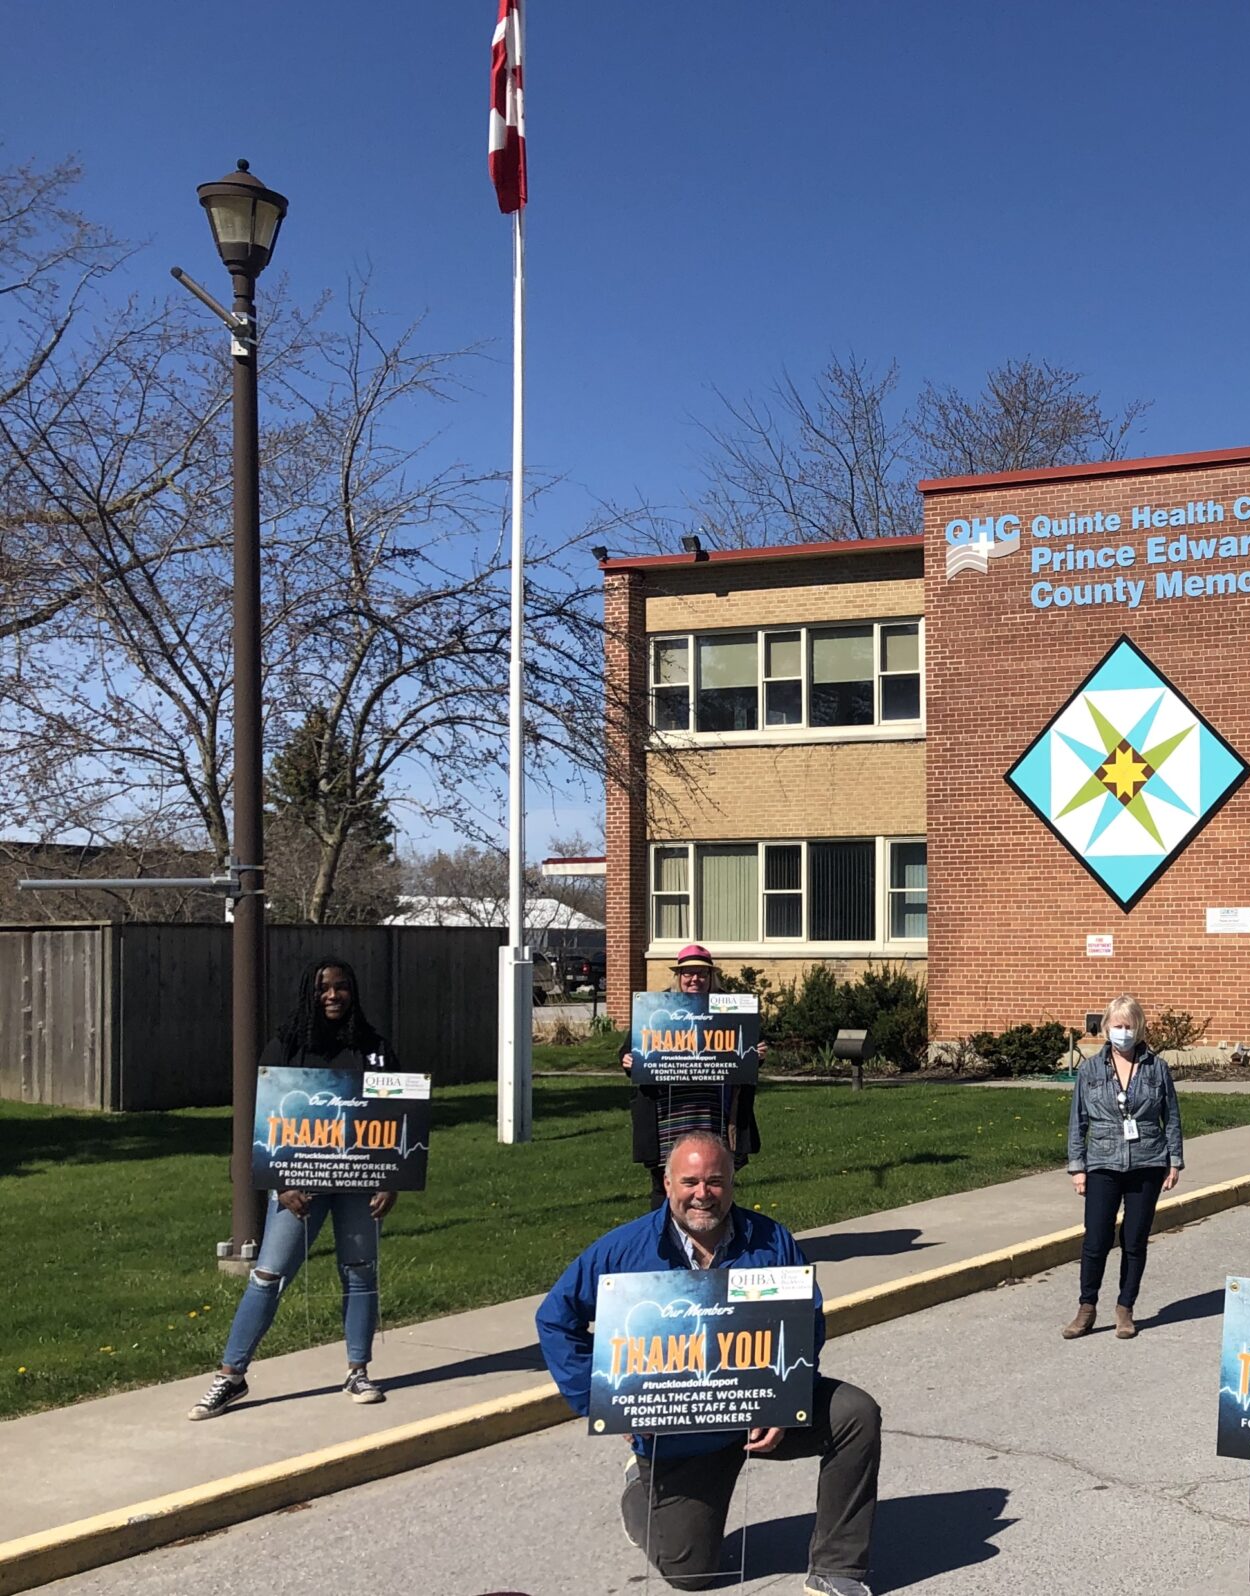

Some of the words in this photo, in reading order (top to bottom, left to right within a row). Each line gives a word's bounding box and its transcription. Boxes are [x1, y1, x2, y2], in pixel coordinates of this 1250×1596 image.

[1032, 512, 1121, 538] Quinte
[1132, 500, 1224, 530] Health
[946, 514, 1020, 545] QHC
[1032, 544, 1136, 573] Prince
[1031, 576, 1145, 609] County
[711, 996, 737, 1004] QHBA
[640, 1030, 697, 1051] THANK
[704, 1030, 735, 1051] YOU
[366, 1076, 401, 1088] QHBA
[267, 1116, 345, 1148] THANK
[354, 1120, 397, 1149] YOU
[279, 1170, 330, 1178] FRONTLINE
[291, 1162, 349, 1170] HEALTHCARE
[353, 1163, 399, 1171] WORKERS,
[731, 1274, 776, 1287] QHBA
[661, 1304, 682, 1318] Our
[683, 1303, 734, 1318] Members
[610, 1333, 705, 1375] THANK
[717, 1331, 771, 1369] YOU
[643, 1378, 738, 1390] #truckloadofsupport
[612, 1395, 635, 1405] FOR
[638, 1392, 712, 1404] HEALTHCARE
[716, 1389, 776, 1400] WORKERS,
[624, 1405, 687, 1416] FRONTLINE
[691, 1403, 726, 1413] STAFF
[729, 1403, 736, 1411] &
[740, 1401, 760, 1410] ALL
[631, 1417, 691, 1427] ESSENTIAL
[695, 1413, 751, 1424] WORKERS
